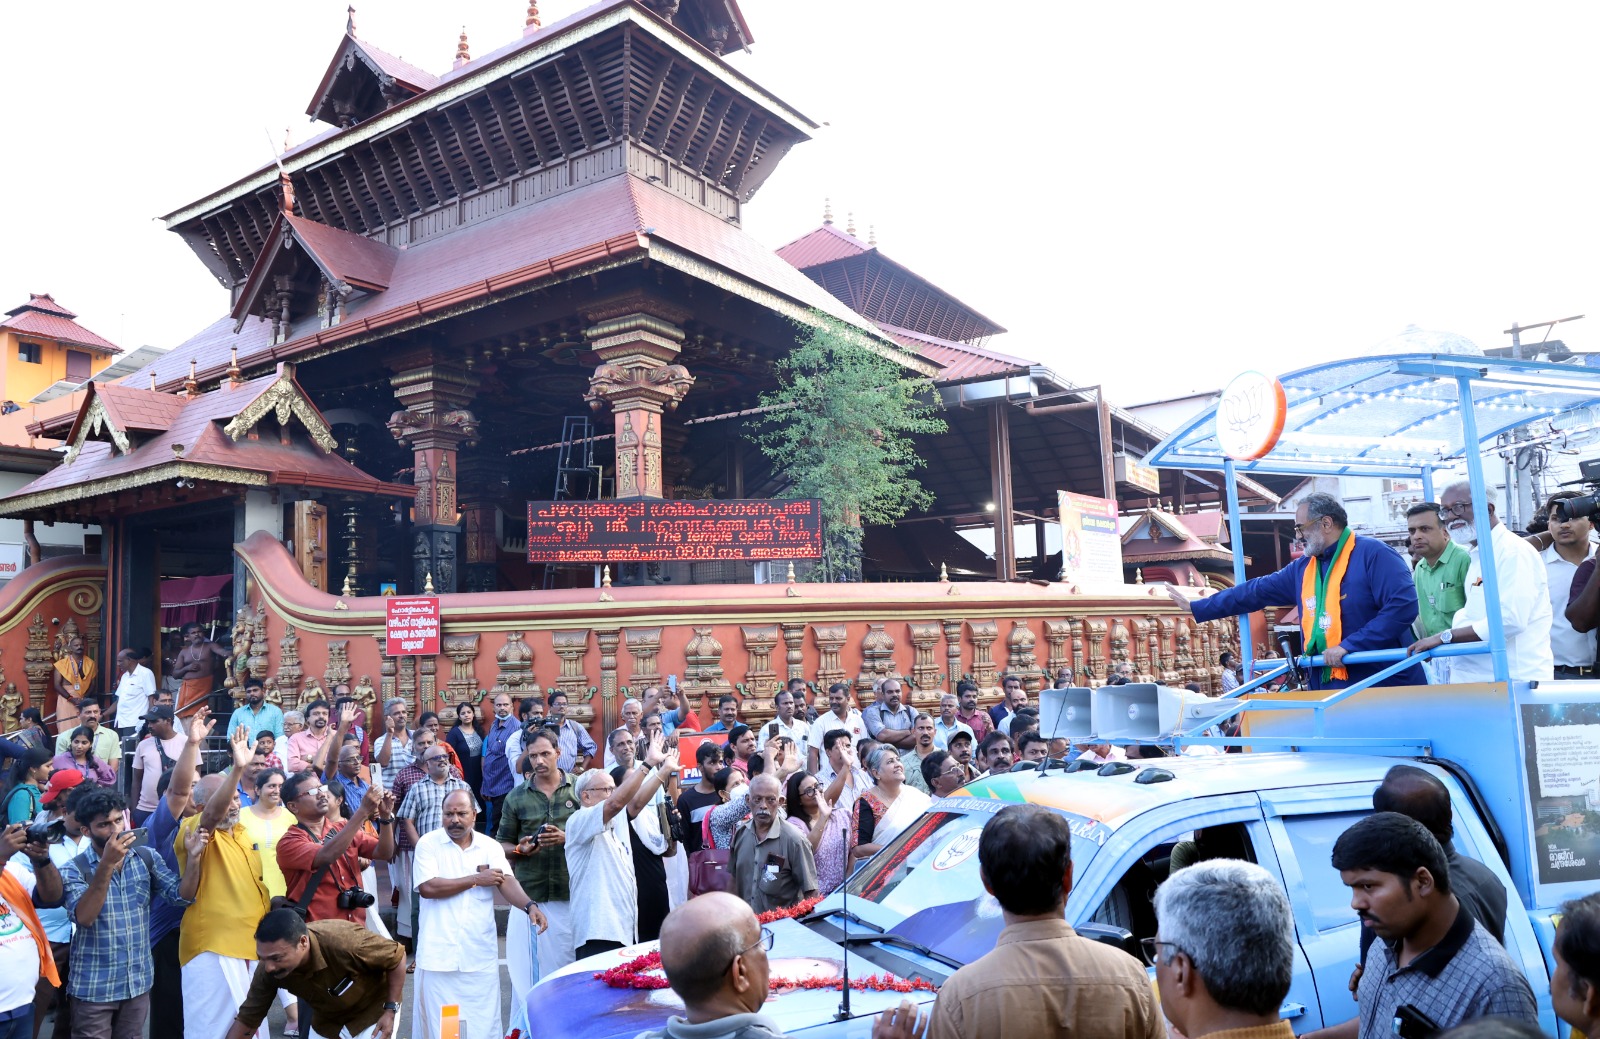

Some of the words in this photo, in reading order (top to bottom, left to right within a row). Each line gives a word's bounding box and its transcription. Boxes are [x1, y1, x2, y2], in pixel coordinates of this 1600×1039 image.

[686, 530, 733, 544] temple
[738, 531, 774, 544] open
[778, 530, 811, 541] from
